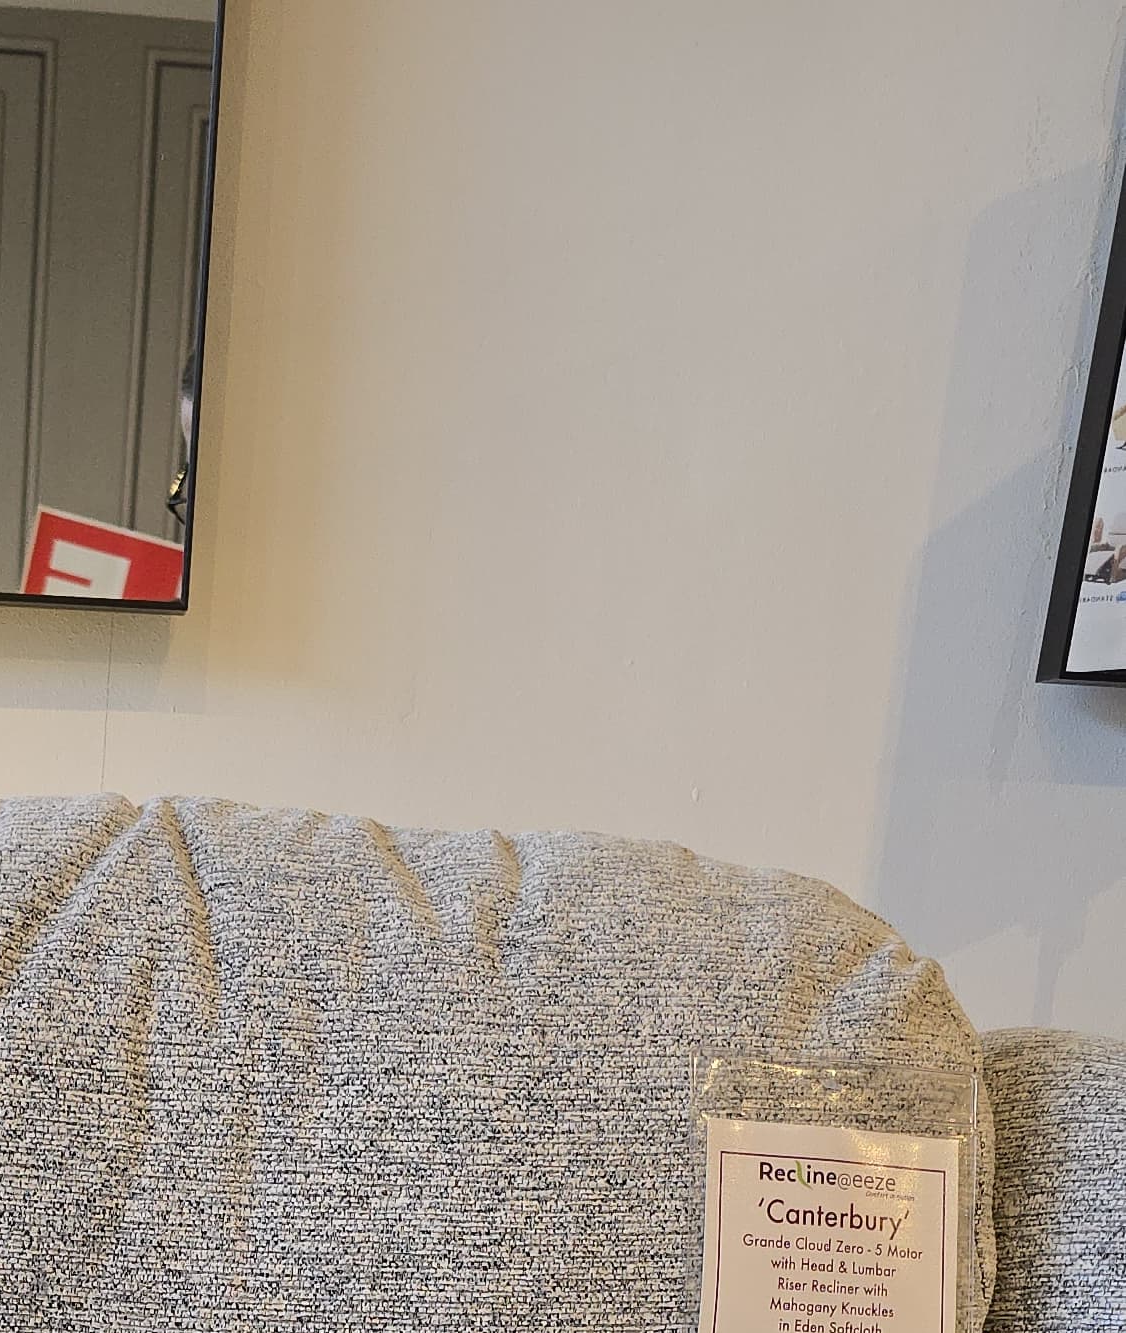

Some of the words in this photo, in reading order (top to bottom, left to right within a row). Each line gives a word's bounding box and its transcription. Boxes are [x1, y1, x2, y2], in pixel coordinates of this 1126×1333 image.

[759, 1160, 896, 1192] Recline@eeze
[742, 1233, 791, 1250] Grande
[795, 1237, 832, 1252] Cloud
[836, 1240, 864, 1255] Zero
[875, 1244, 883, 1256] 5
[887, 1245, 923, 1260] Motor
[771, 1257, 796, 1271] with
[801, 1258, 834, 1273] Head
[838, 1261, 848, 1274] &
[852, 1261, 897, 1278] Lumbar
[777, 1277, 808, 1292] Riser
[811, 1279, 860, 1295] Recliner
[863, 1282, 889, 1297] with
[770, 1297, 837, 1318] Mahogany
[841, 1301, 895, 1318] Knuckles
[778, 1318, 790, 1332] in
[794, 1320, 825, 1333] Eden
